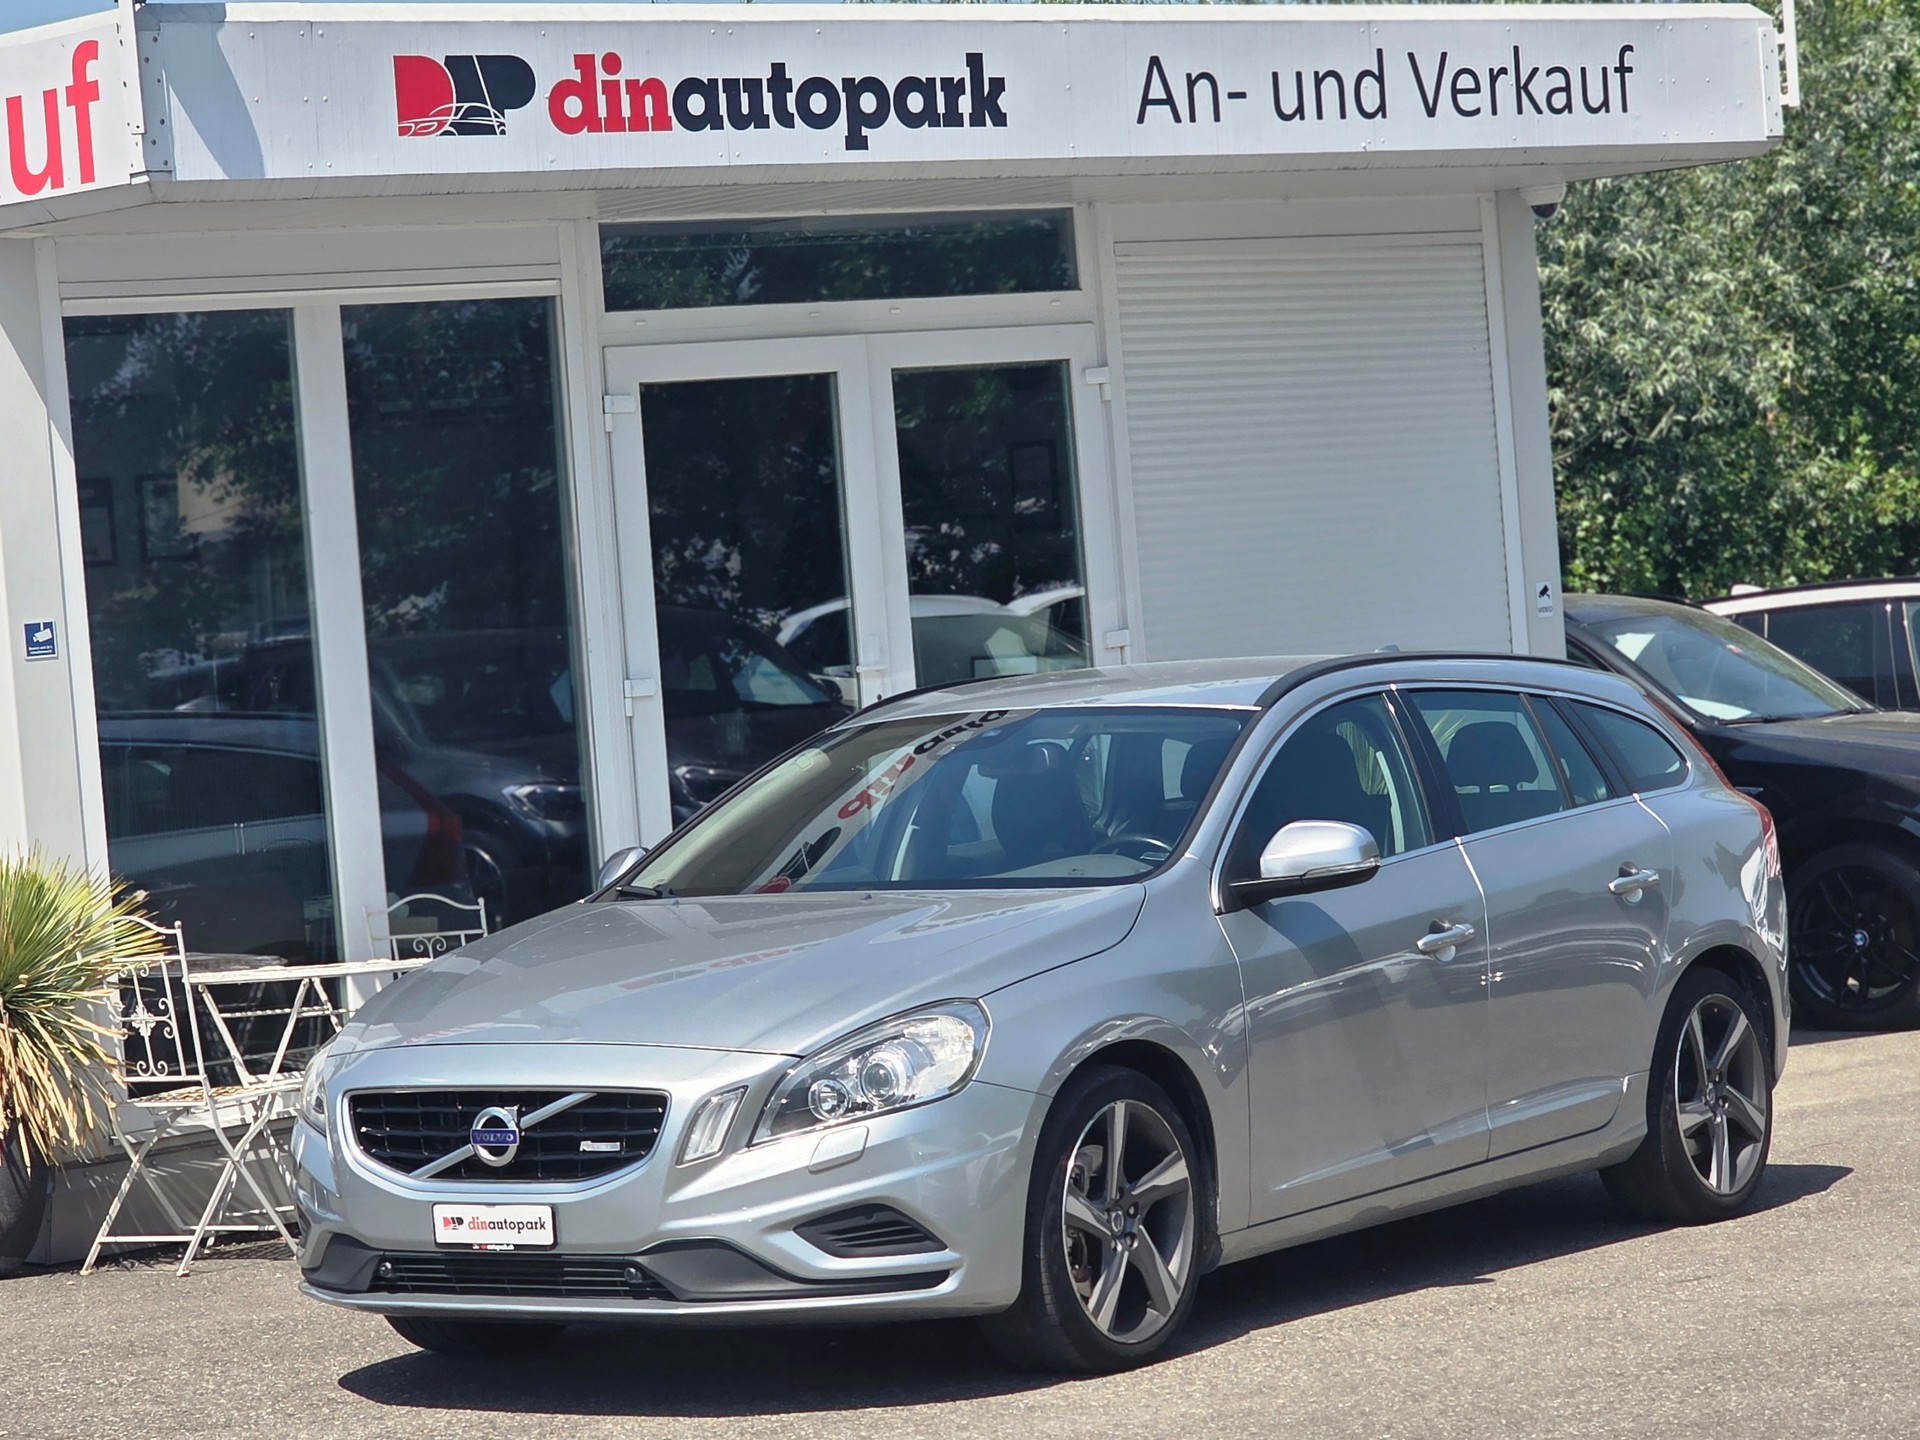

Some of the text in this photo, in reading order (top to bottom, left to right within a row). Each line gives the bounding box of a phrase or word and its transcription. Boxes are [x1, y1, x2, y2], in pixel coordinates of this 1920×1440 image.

[5, 40, 100, 195] uf
[548, 52, 1008, 151] dinautopark
[1137, 44, 1634, 124] An- und Verkauf
[473, 1132, 514, 1142] VOLVO
[468, 1216, 546, 1234] dinautopark
